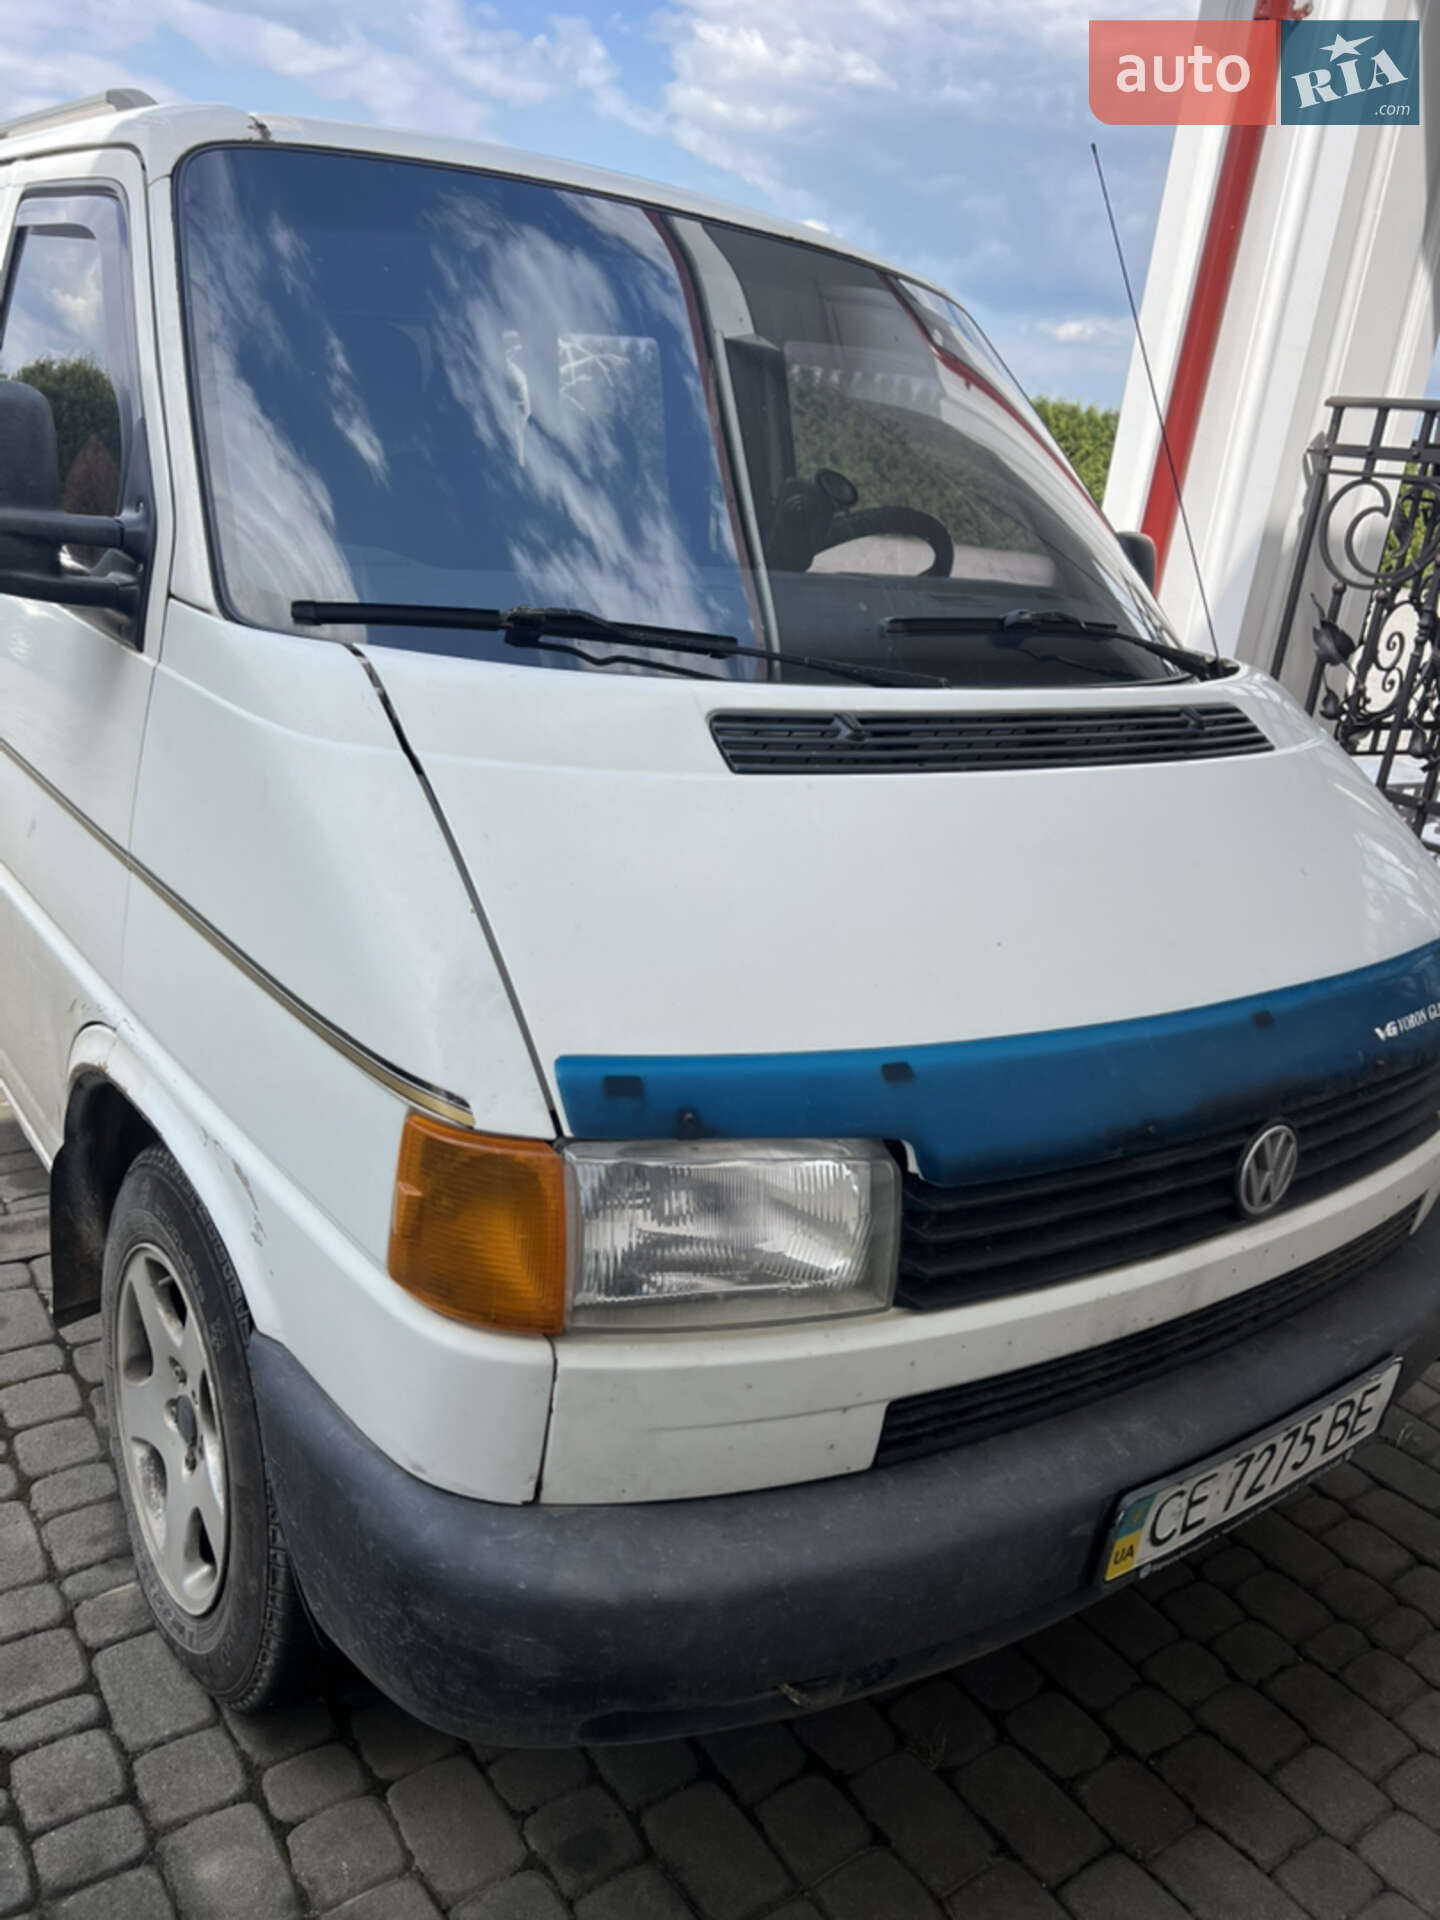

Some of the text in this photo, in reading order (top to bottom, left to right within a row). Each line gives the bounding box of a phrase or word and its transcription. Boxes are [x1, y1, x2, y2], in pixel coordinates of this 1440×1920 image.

[1150, 1472, 1218, 1547] CE
[1222, 1414, 1323, 1512] 7275
[1322, 1383, 1382, 1455] BE
[1113, 1544, 1134, 1565] UA
